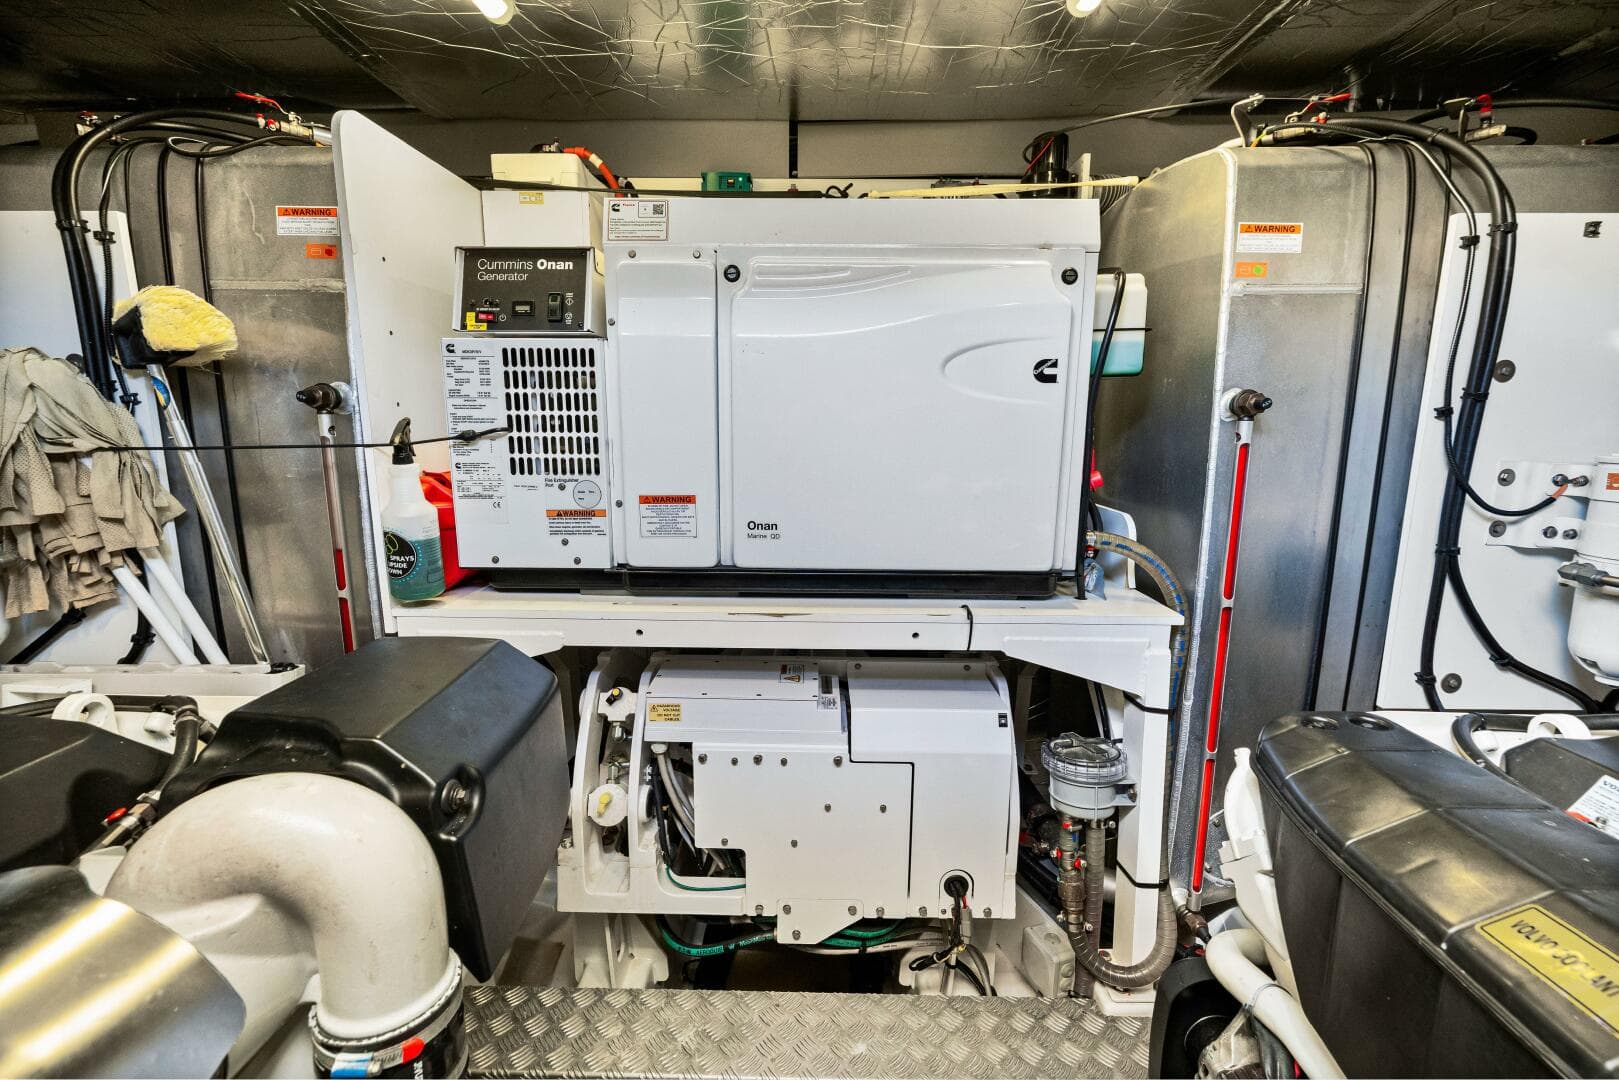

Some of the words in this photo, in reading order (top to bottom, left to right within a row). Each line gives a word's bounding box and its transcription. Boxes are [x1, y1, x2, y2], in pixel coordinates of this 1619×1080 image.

[291, 208, 332, 216] WARNING
[1254, 225, 1296, 233] WARNING
[477, 258, 534, 271] Cummins
[536, 258, 574, 270] Onan
[477, 271, 529, 282] Generator
[652, 496, 692, 504] WARNING
[562, 510, 596, 518] WARNING
[747, 520, 778, 531] Onan
[390, 554, 415, 562] SPRAYS
[1510, 919, 1559, 950] VOLVO
